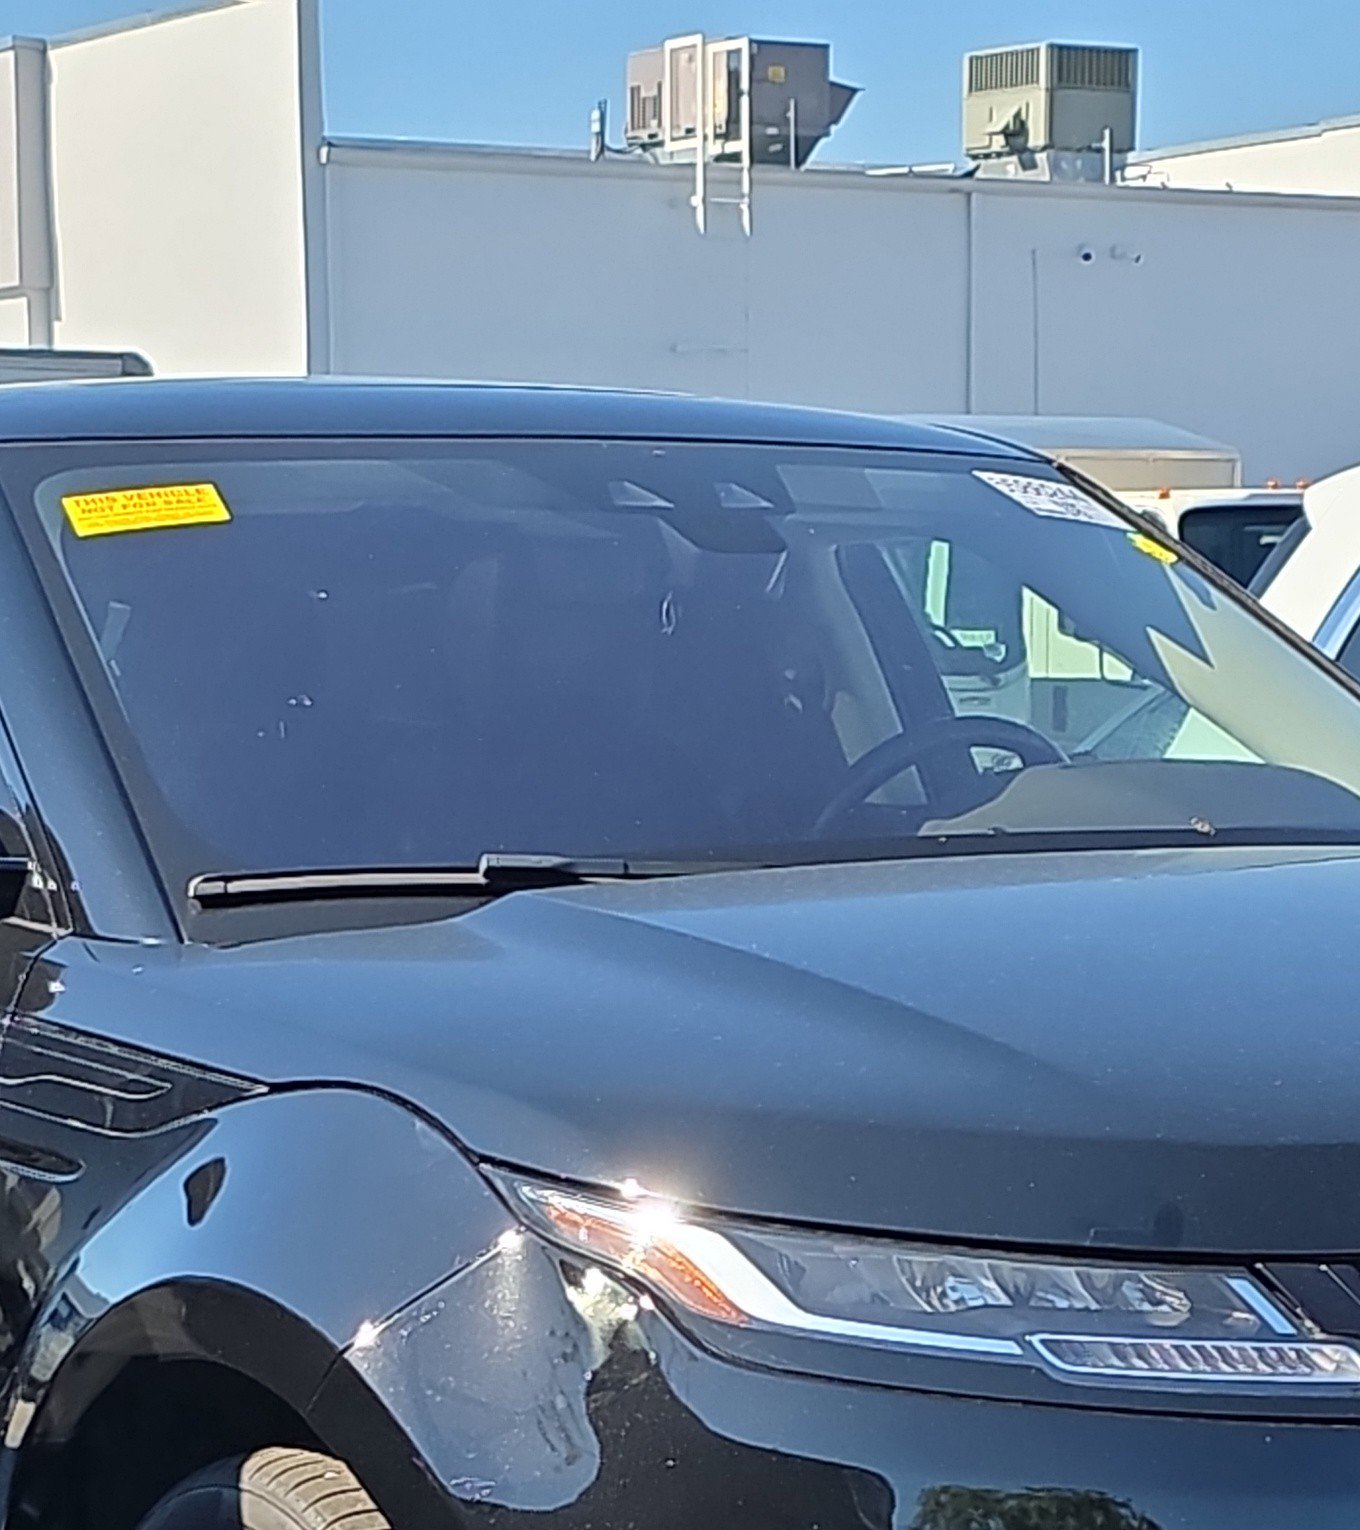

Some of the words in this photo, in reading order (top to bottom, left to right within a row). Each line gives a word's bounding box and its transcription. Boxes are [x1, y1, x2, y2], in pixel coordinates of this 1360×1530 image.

[74, 494, 117, 508] THIS
[123, 487, 209, 503] VEHICLE
[81, 505, 115, 515] NOT
[122, 500, 157, 511] FOR
[163, 496, 206, 506] SALE
